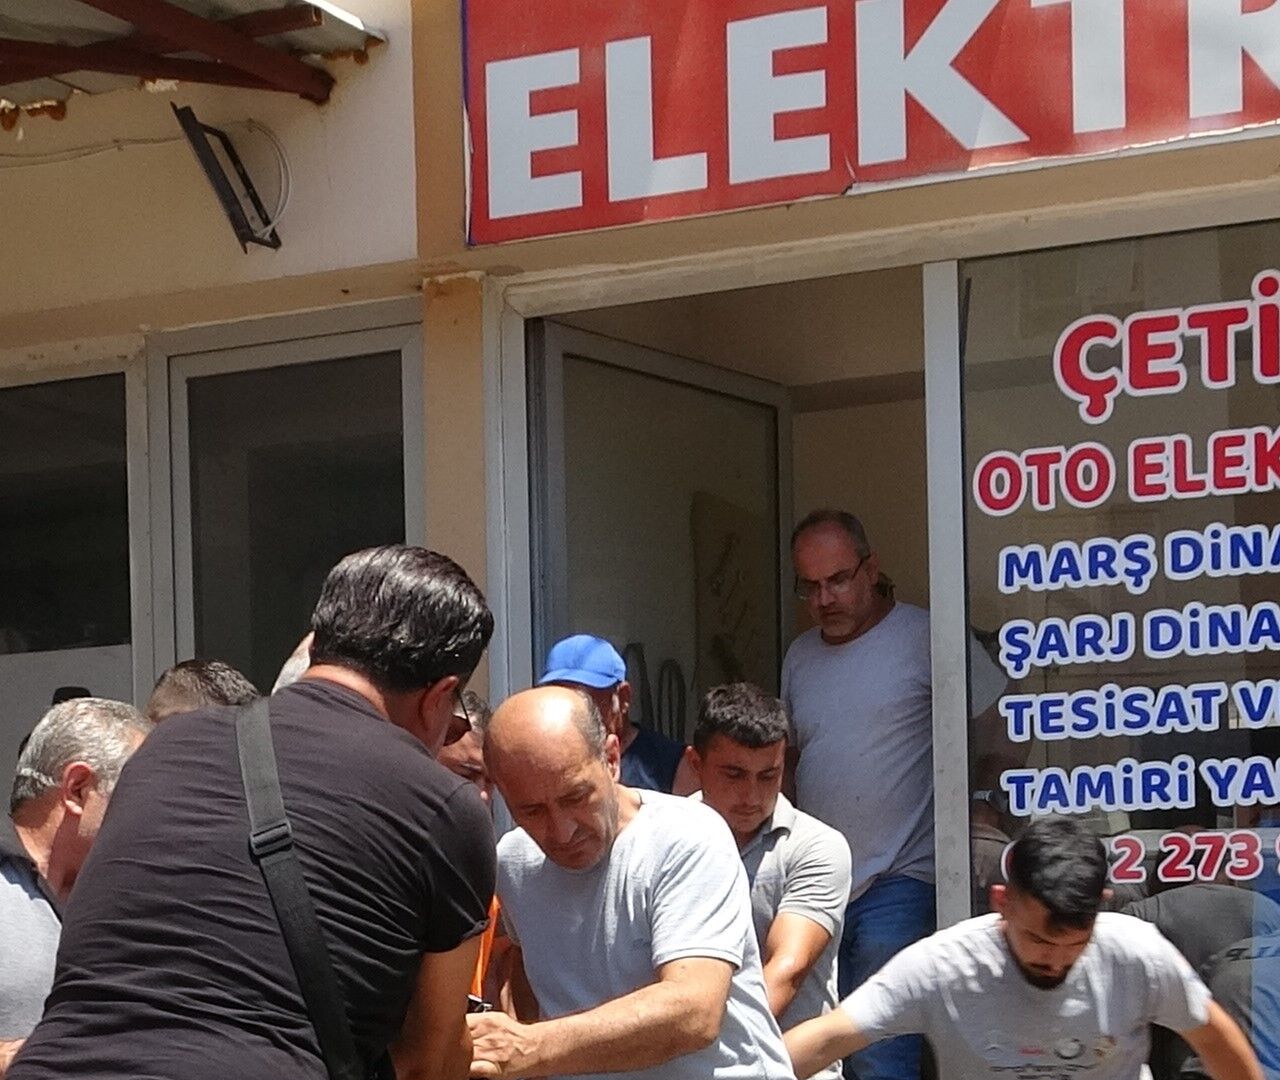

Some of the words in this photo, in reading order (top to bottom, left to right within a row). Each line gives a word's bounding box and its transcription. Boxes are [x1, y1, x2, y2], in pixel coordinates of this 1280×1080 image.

[976, 446, 1111, 512] OTO
[1003, 538, 1153, 589] MARŞ
[1003, 616, 1130, 673] ŞARJ
[1156, 831, 1261, 881] 273
